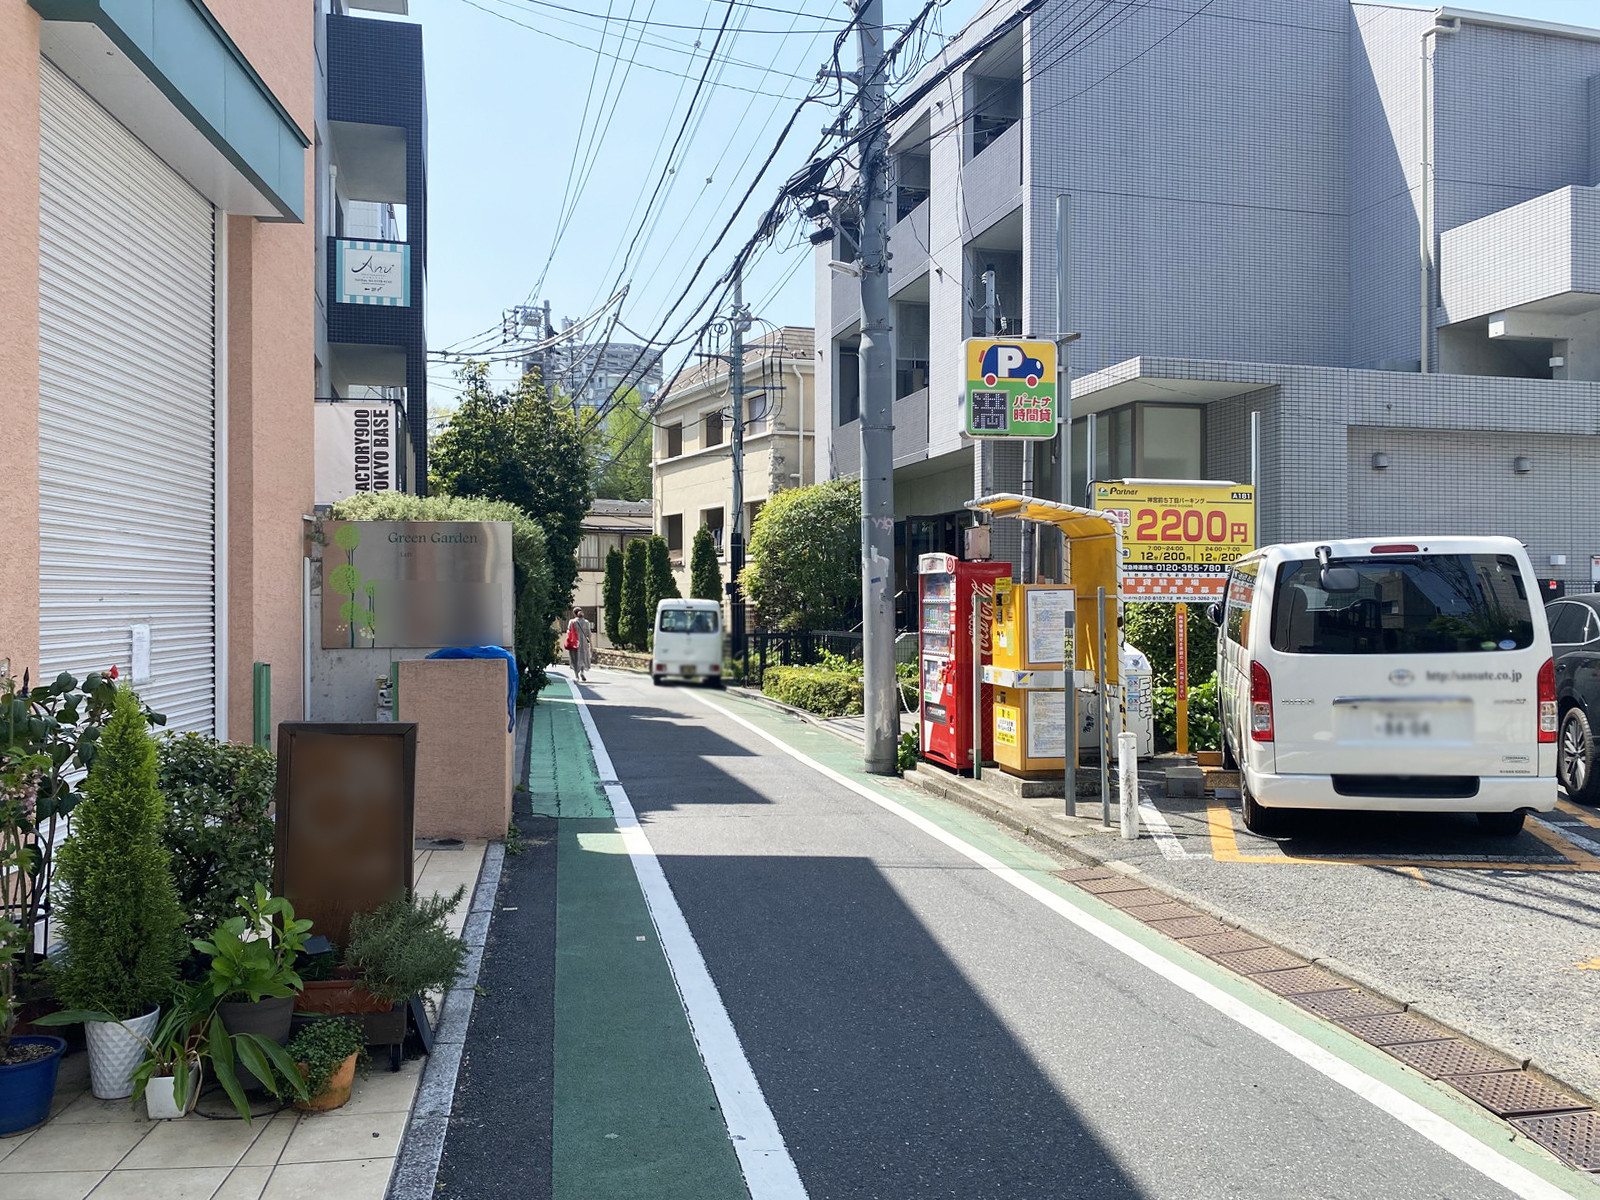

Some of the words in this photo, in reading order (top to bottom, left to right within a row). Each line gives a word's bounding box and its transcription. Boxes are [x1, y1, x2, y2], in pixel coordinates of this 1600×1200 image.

[997, 347, 1023, 377] P
[1013, 408, 1052, 422] 時間貸
[373, 409, 389, 447] BASE
[1110, 487, 1138, 496] Partner
[388, 532, 426, 543] Green
[430, 532, 478, 544] Garden
